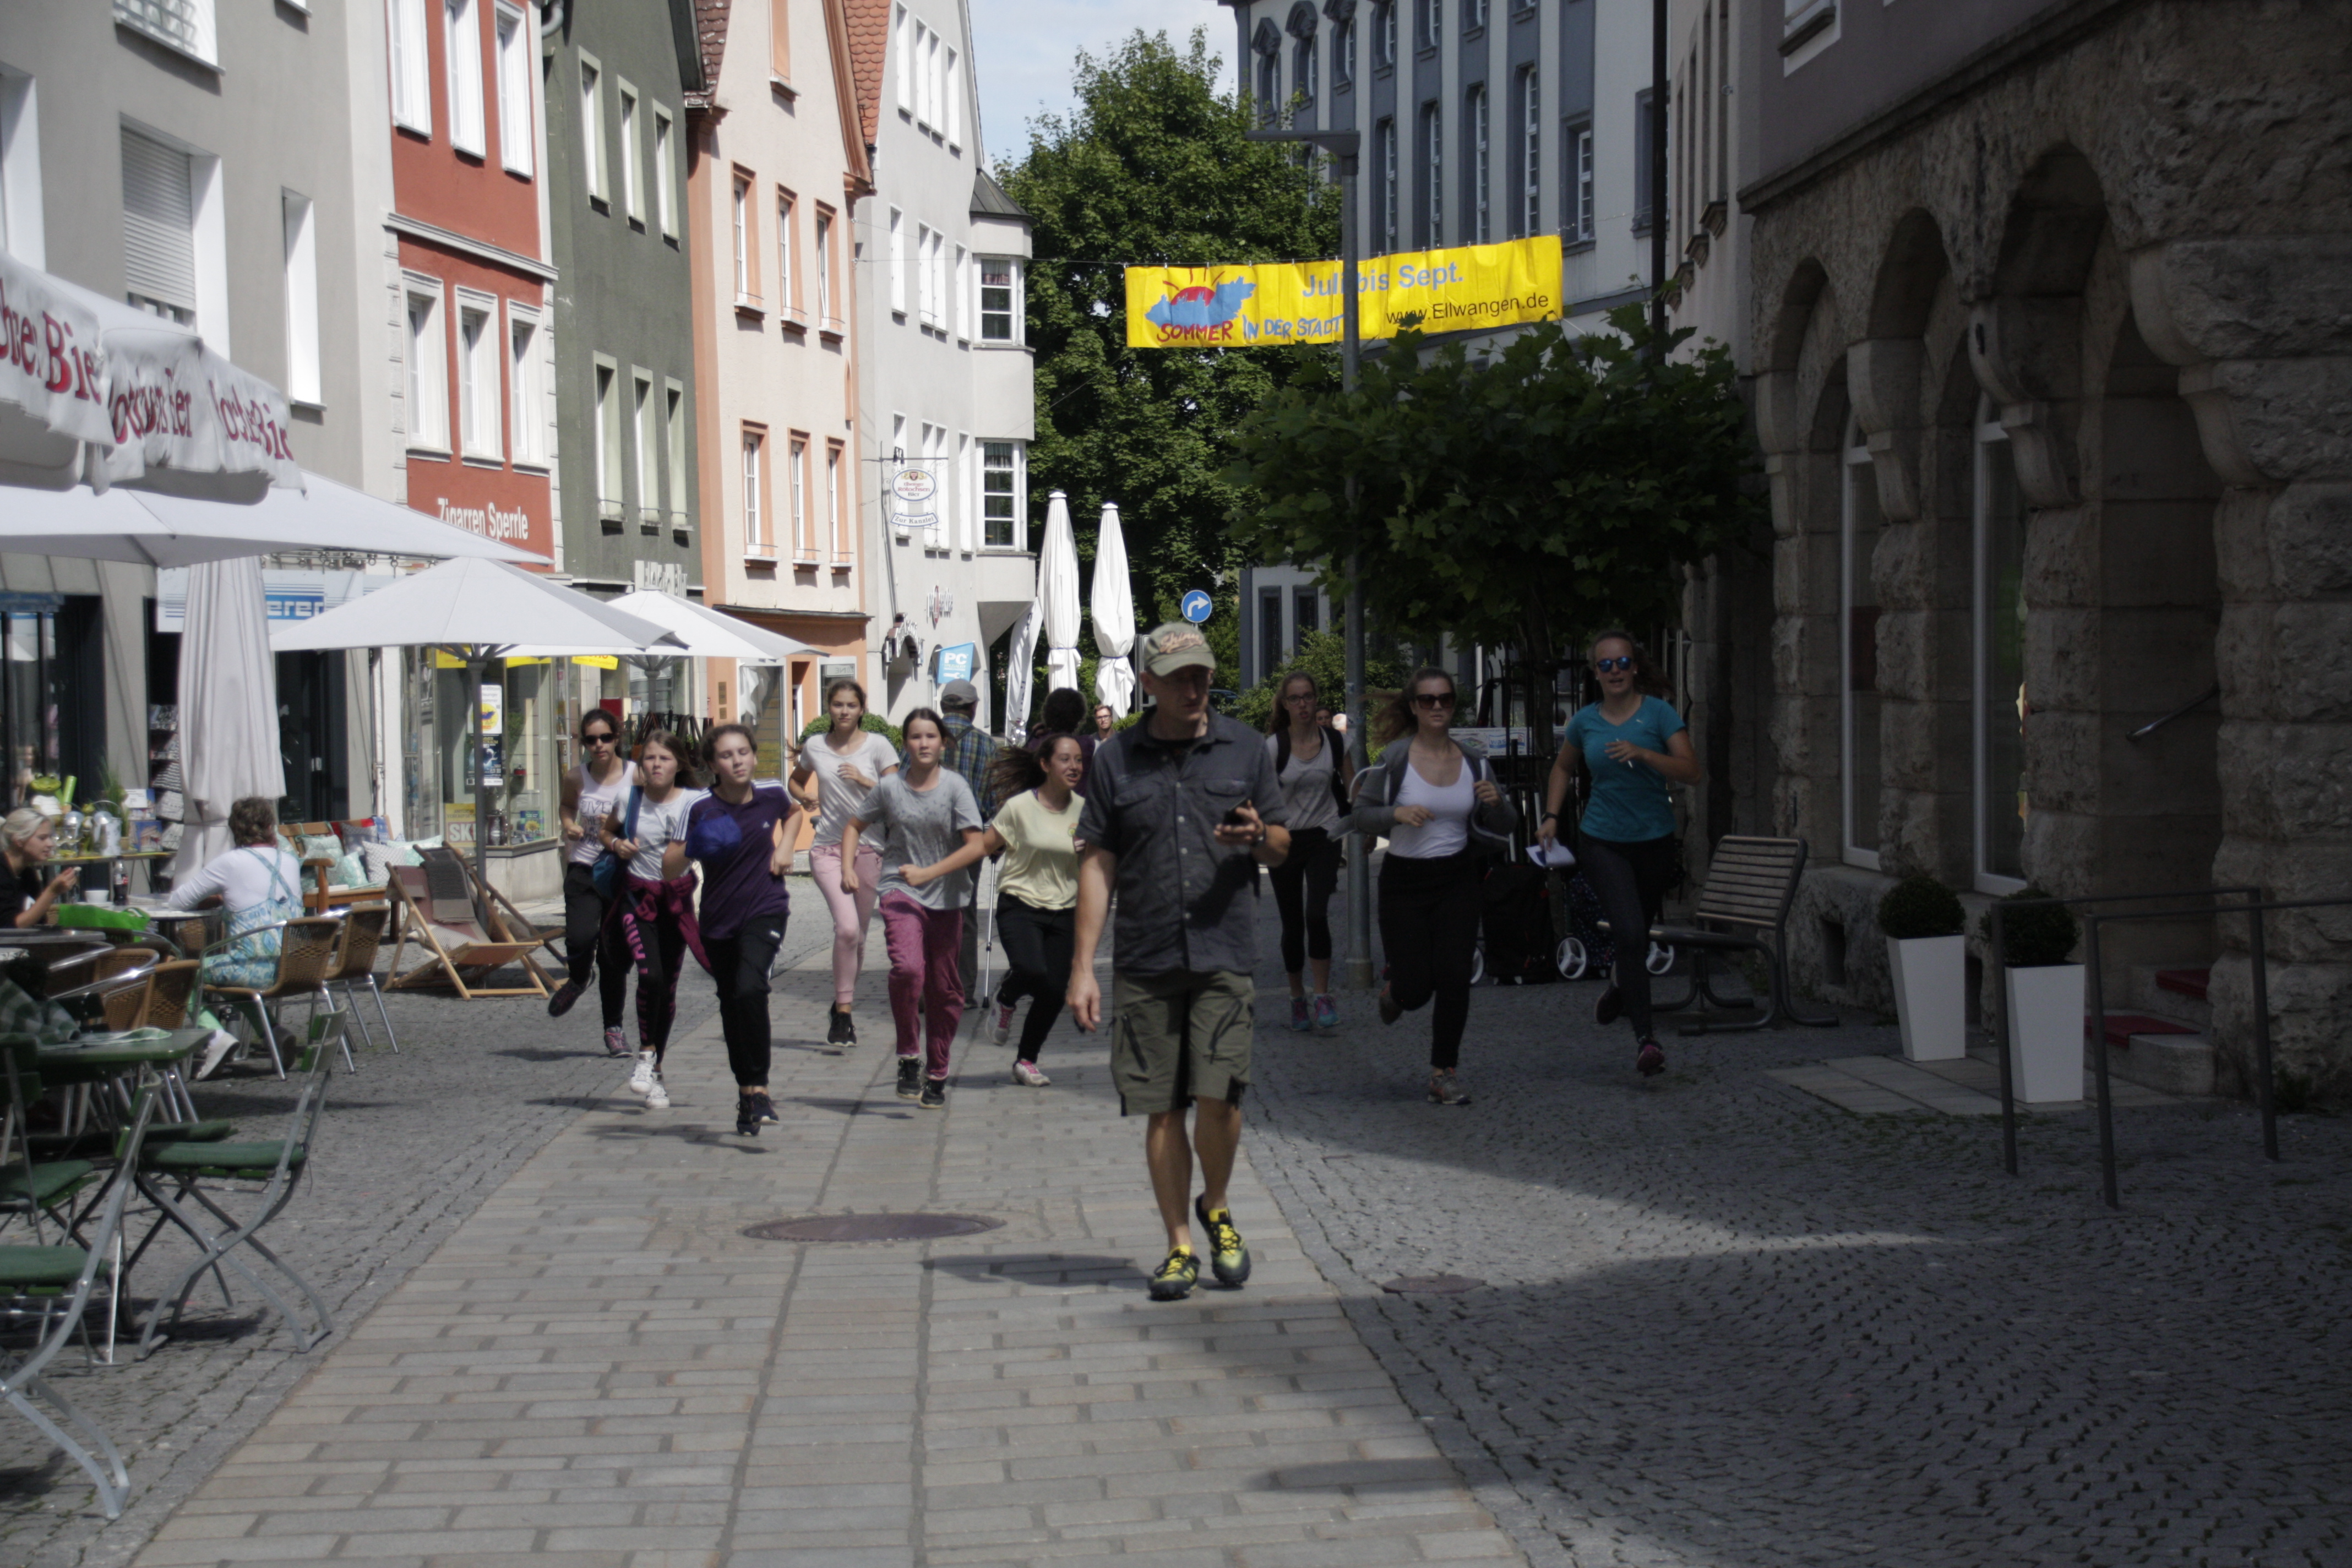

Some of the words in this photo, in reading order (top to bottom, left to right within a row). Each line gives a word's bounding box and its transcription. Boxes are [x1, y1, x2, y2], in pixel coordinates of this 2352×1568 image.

[1358, 269, 1389, 292] bis
[1398, 261, 1464, 290] Sept.
[1157, 320, 1233, 342] SOMMER
[1243, 314, 1259, 340] IN
[1264, 319, 1292, 339] DER
[1297, 314, 1344, 337] STADT
[488, 502, 529, 541] Sperrle
[944, 652, 967, 665] PC
